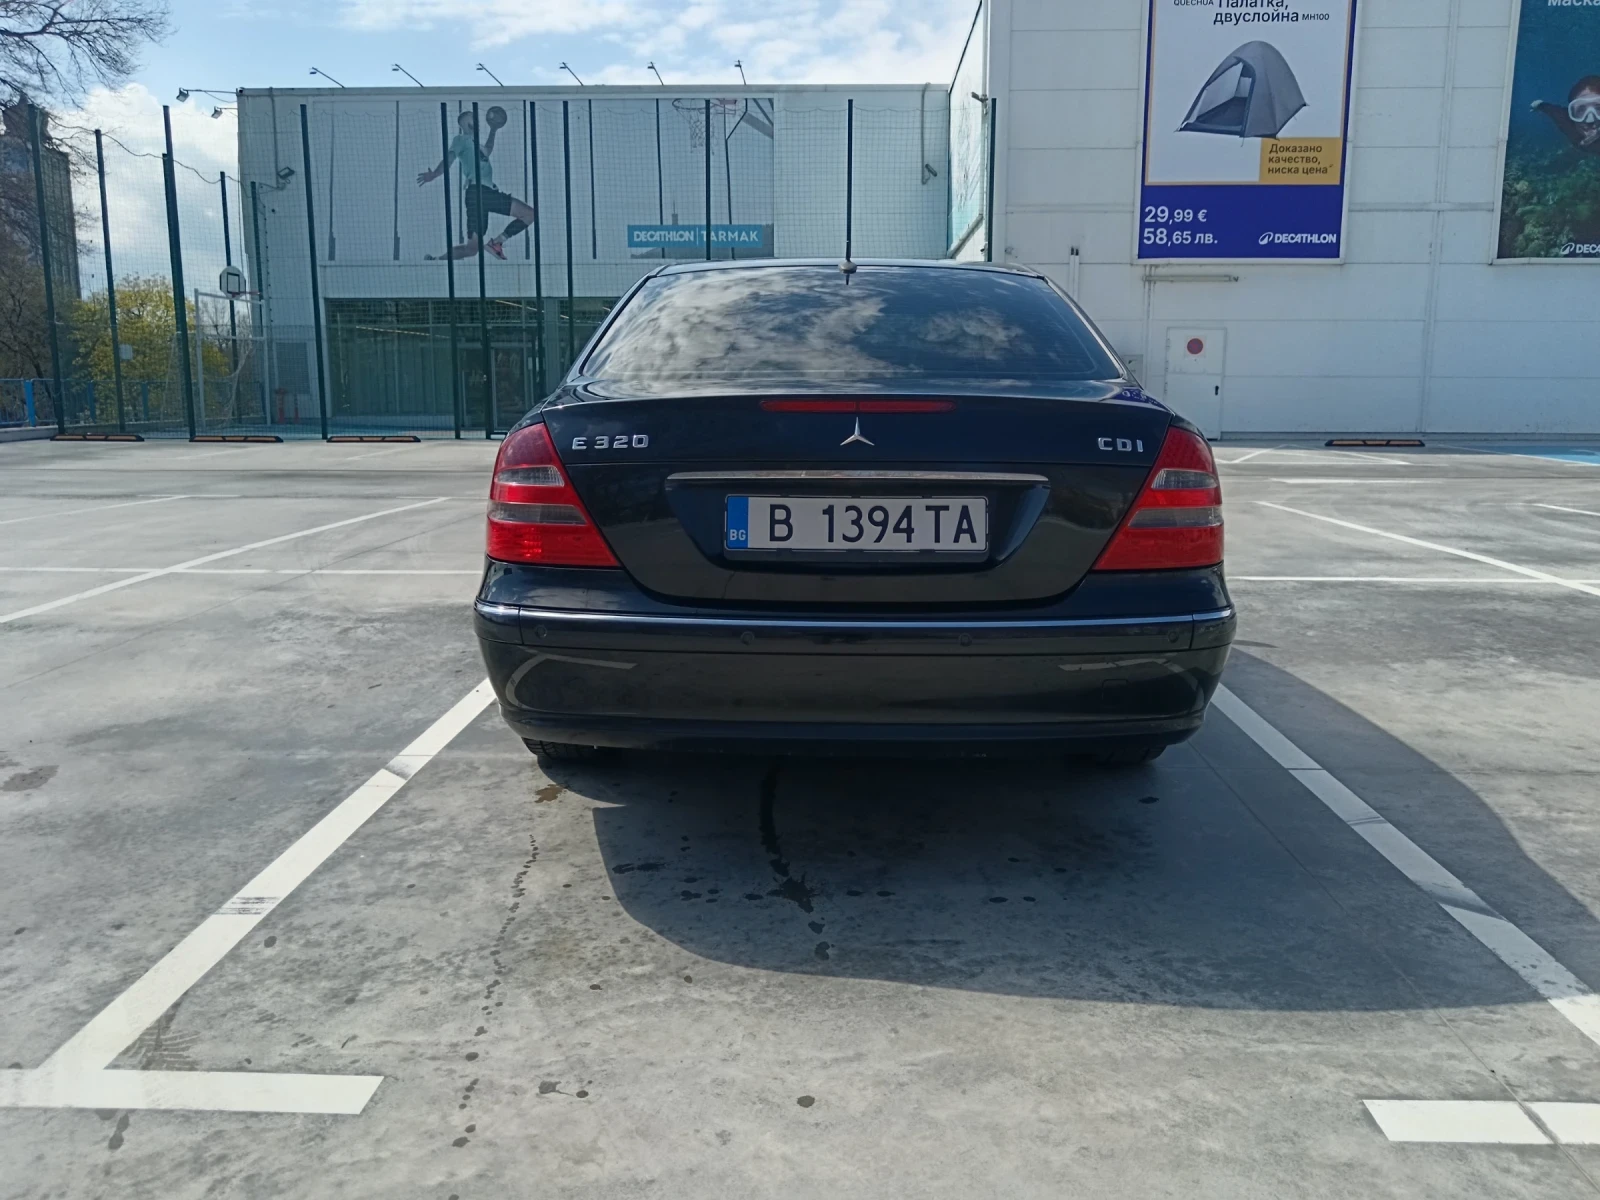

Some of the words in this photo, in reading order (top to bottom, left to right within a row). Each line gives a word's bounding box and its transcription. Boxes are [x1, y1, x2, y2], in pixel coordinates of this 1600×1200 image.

[1213, 9, 1299, 26] двуслойна
[1302, 13, 1330, 21] MH100
[1269, 143, 1323, 154] Доказано
[1268, 156, 1321, 166] качество,
[1268, 166, 1300, 174] ниска
[1144, 205, 1193, 225] 29,99
[1197, 209, 1208, 222] €
[633, 230, 695, 242] DECATHLON
[701, 230, 759, 242] TARMAK
[1143, 228, 1192, 247] 58,65
[1194, 233, 1218, 244] лв.
[1274, 233, 1337, 243] DECATHLON
[572, 437, 588, 450] E
[594, 434, 649, 450] 320
[1098, 437, 1144, 453] CDI
[730, 529, 746, 541] BG
